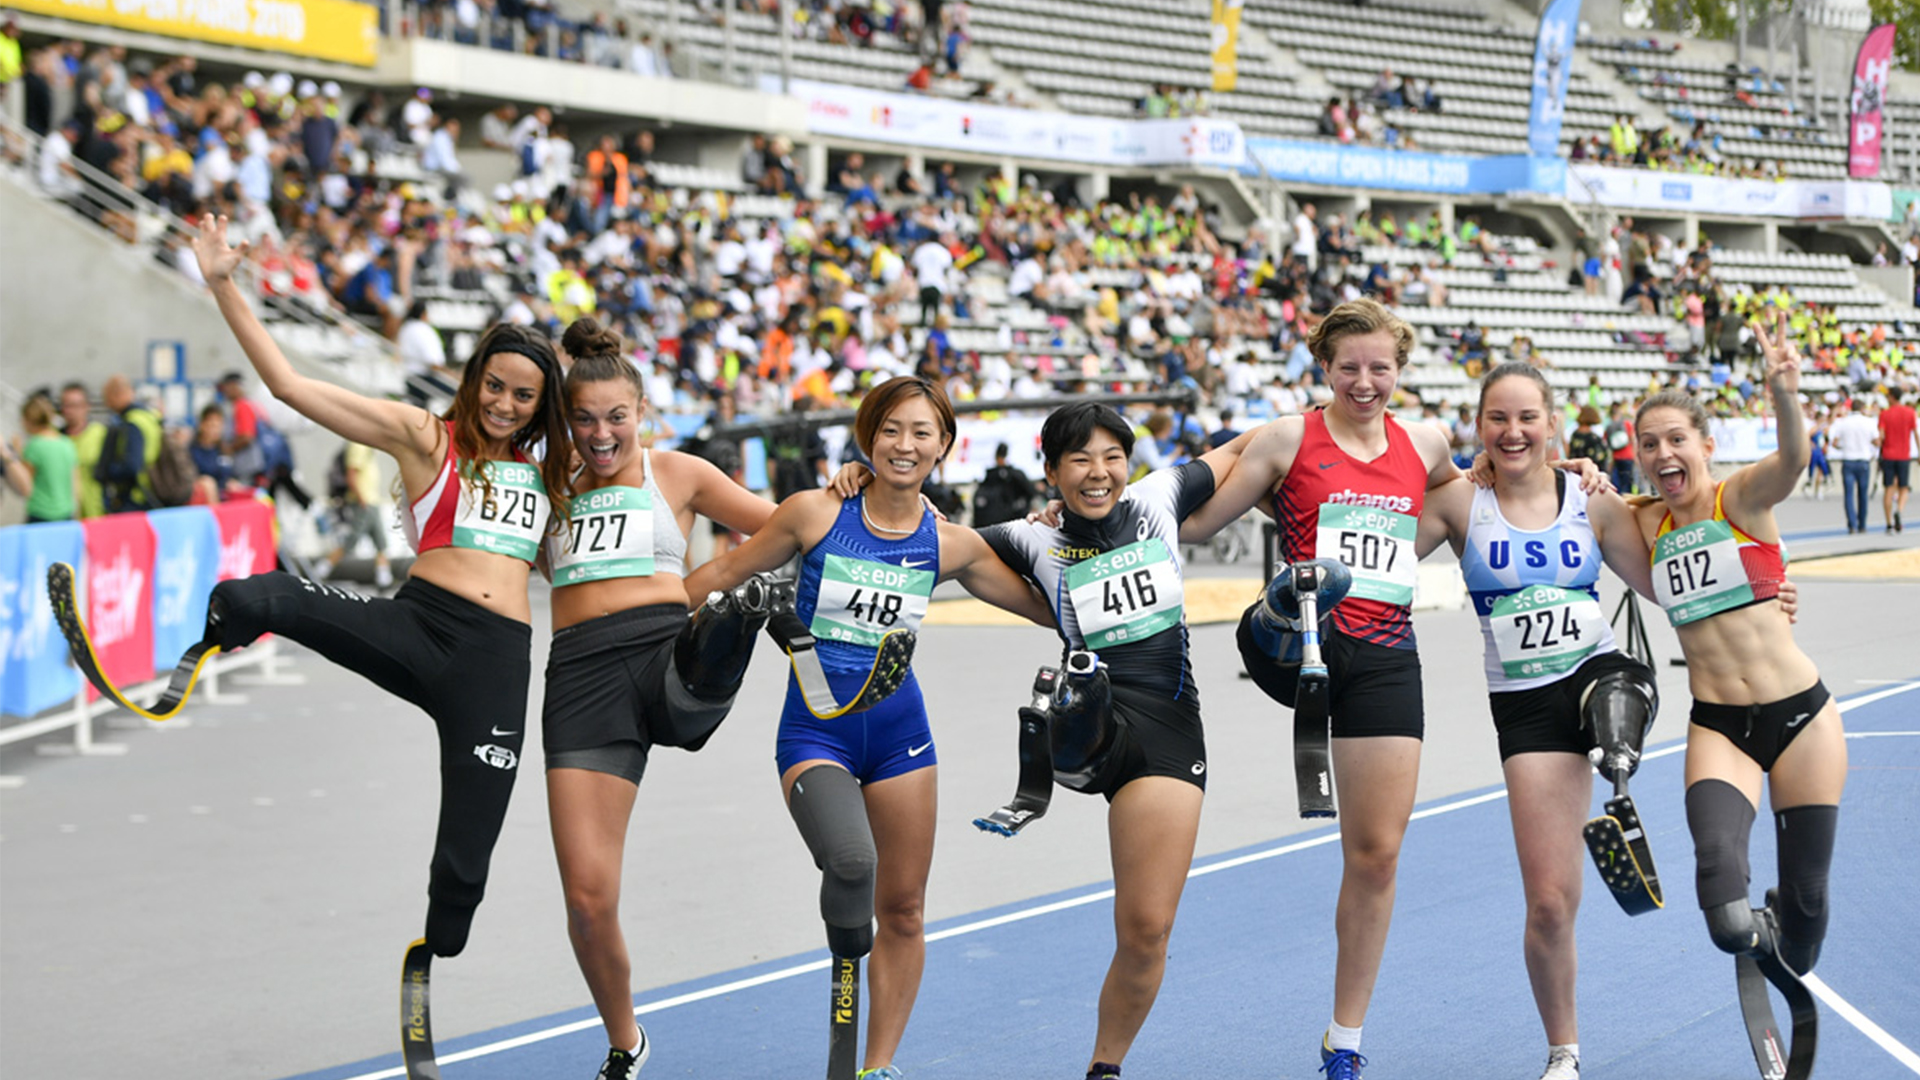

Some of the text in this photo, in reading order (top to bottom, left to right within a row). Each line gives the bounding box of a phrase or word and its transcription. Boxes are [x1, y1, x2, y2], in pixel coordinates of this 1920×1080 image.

[252, 1, 305, 43] 2019
[1386, 155, 1429, 185] PARIS
[1431, 160, 1469, 188] 2019
[503, 467, 537, 486] eDF
[480, 486, 537, 530] 629
[590, 491, 625, 509] eDF
[571, 513, 627, 554] 727
[1365, 513, 1398, 531] eDF
[1675, 527, 1706, 549] eDF
[1339, 531, 1398, 572] 507
[872, 568, 909, 588] eDF
[1103, 569, 1158, 615] 416
[1666, 549, 1718, 596] 612
[845, 588, 903, 627] 418
[1513, 606, 1582, 650] 224
[409, 970, 425, 1027] ÖSSUR
[836, 958, 854, 1008] ÖSSU
